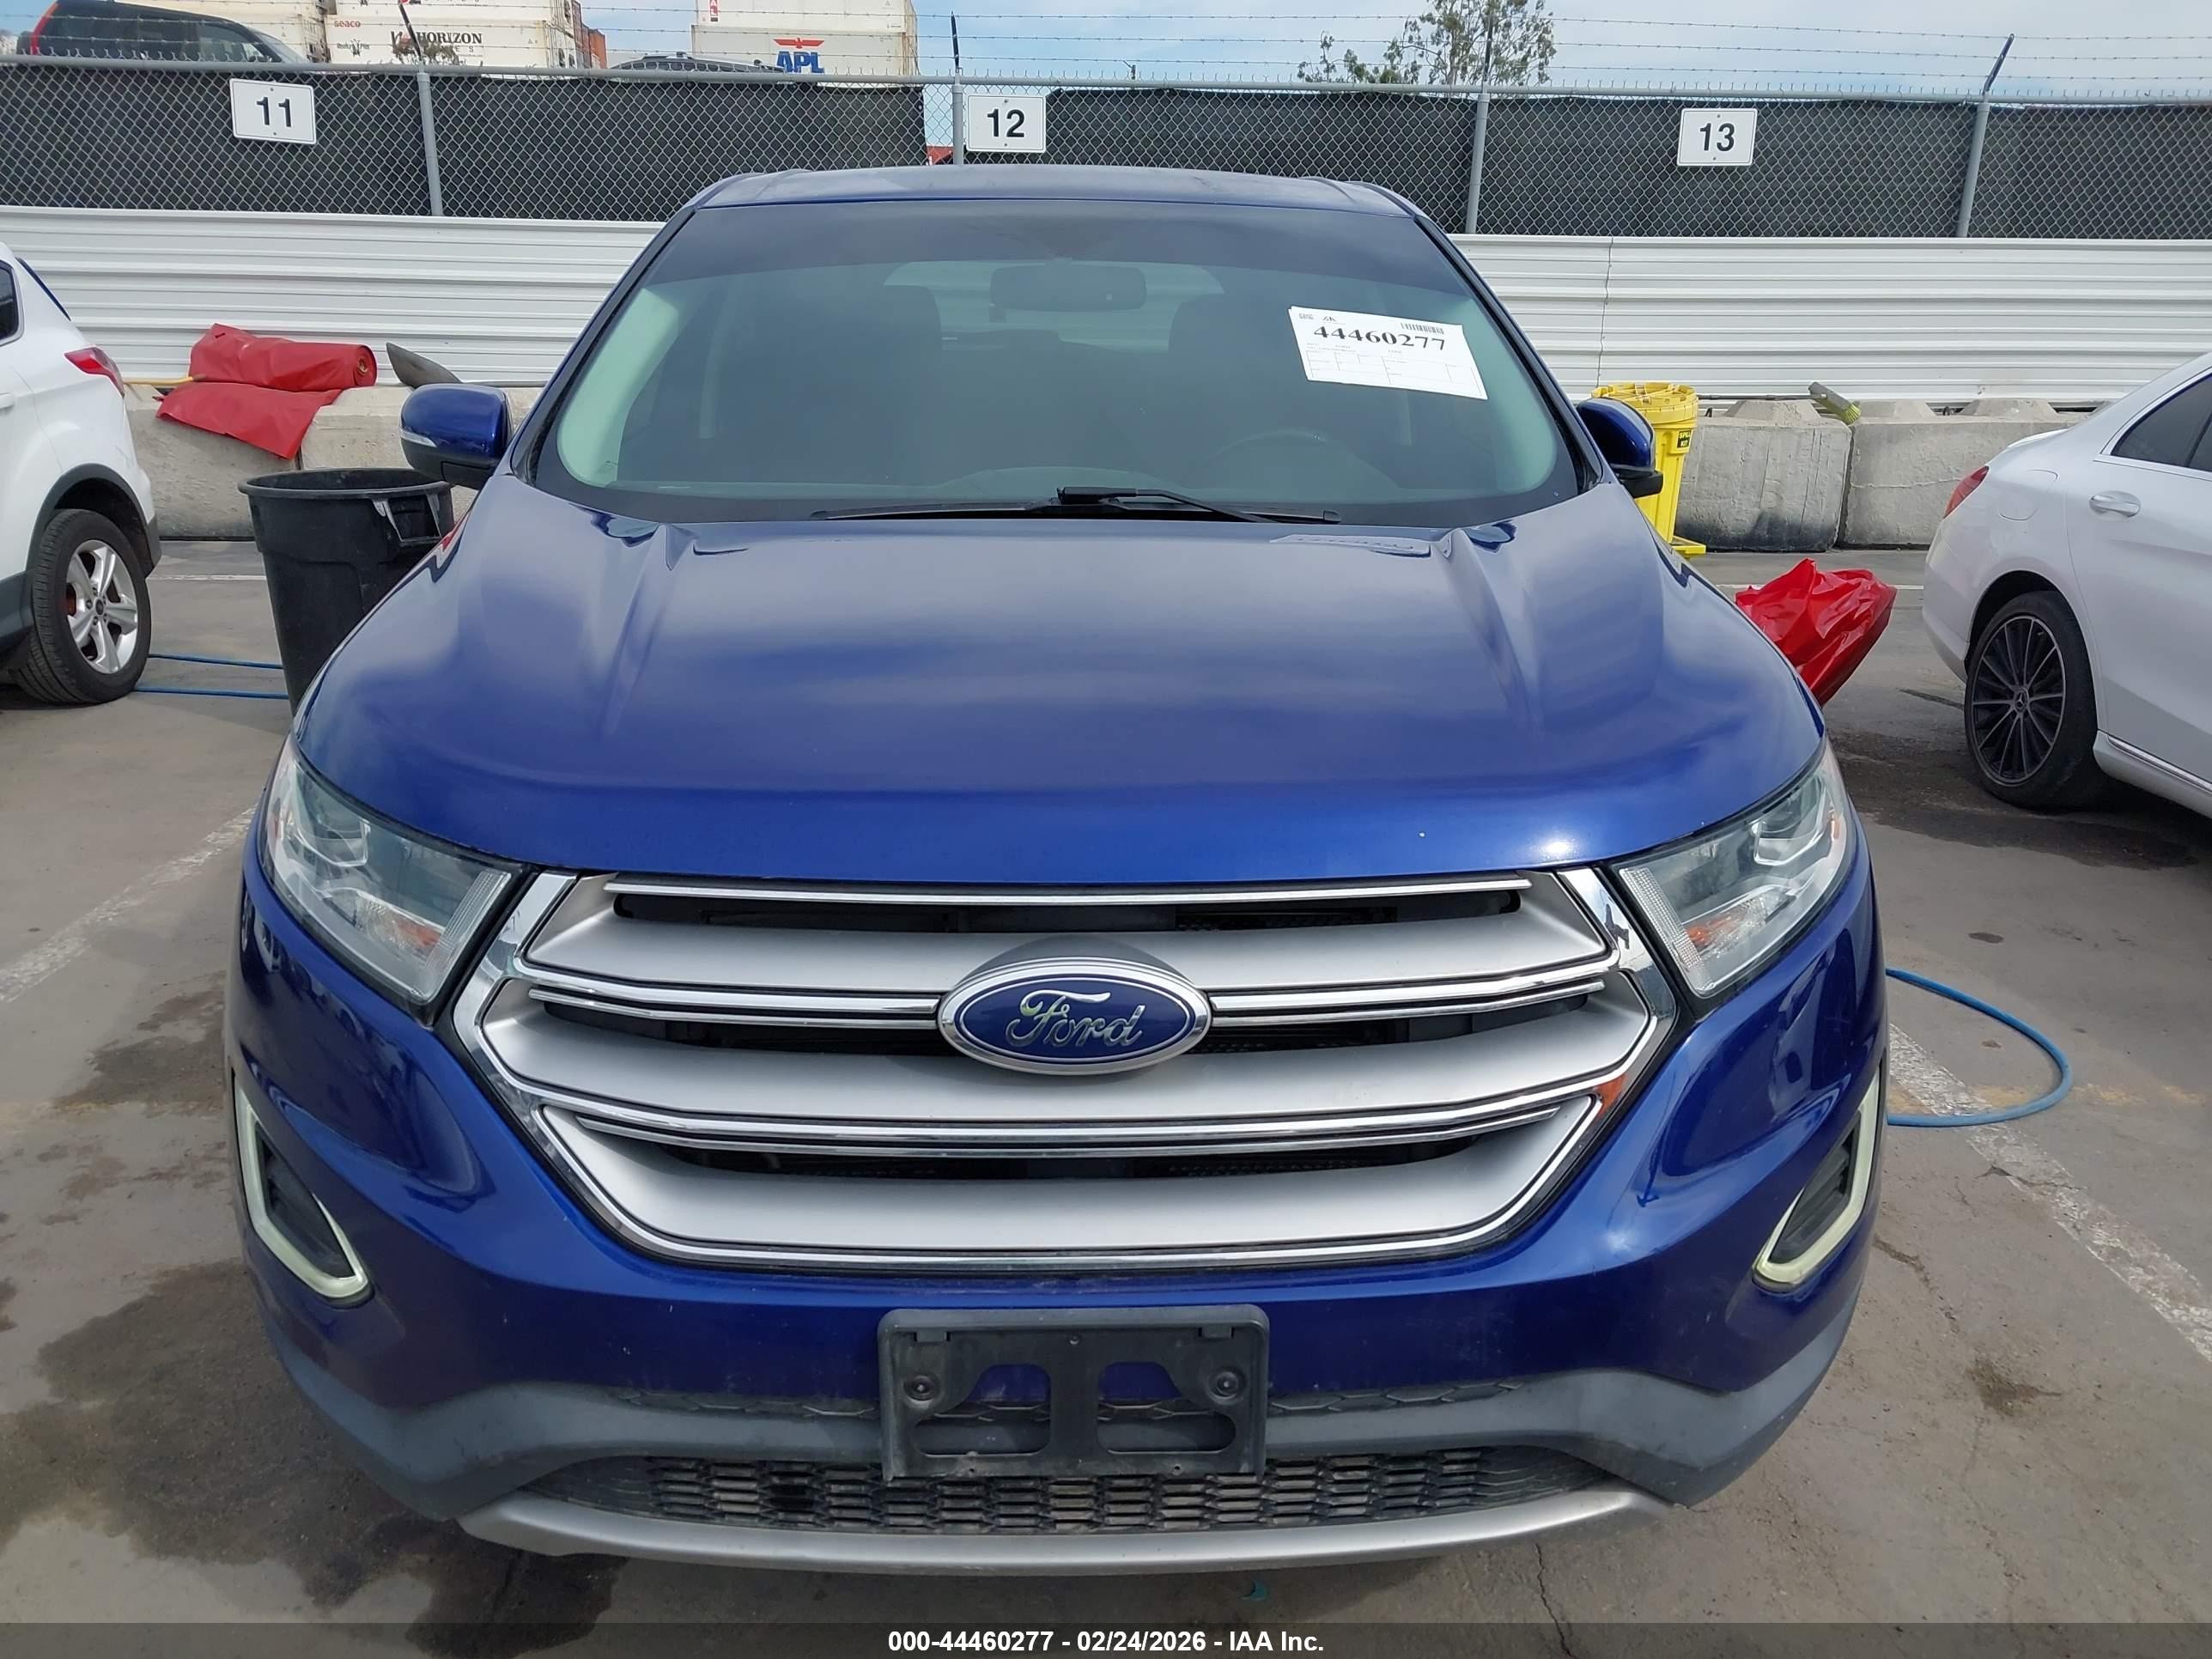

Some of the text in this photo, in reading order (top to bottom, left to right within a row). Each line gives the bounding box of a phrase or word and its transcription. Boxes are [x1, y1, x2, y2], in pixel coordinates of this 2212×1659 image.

[416, 31, 483, 45] HORIZON
[776, 51, 824, 74] APL
[255, 96, 293, 128] 11
[986, 108, 1025, 138] 12
[1699, 123, 1735, 152] 13
[1314, 325, 1445, 350] 44460277
[1005, 988, 1146, 1048] Ford
